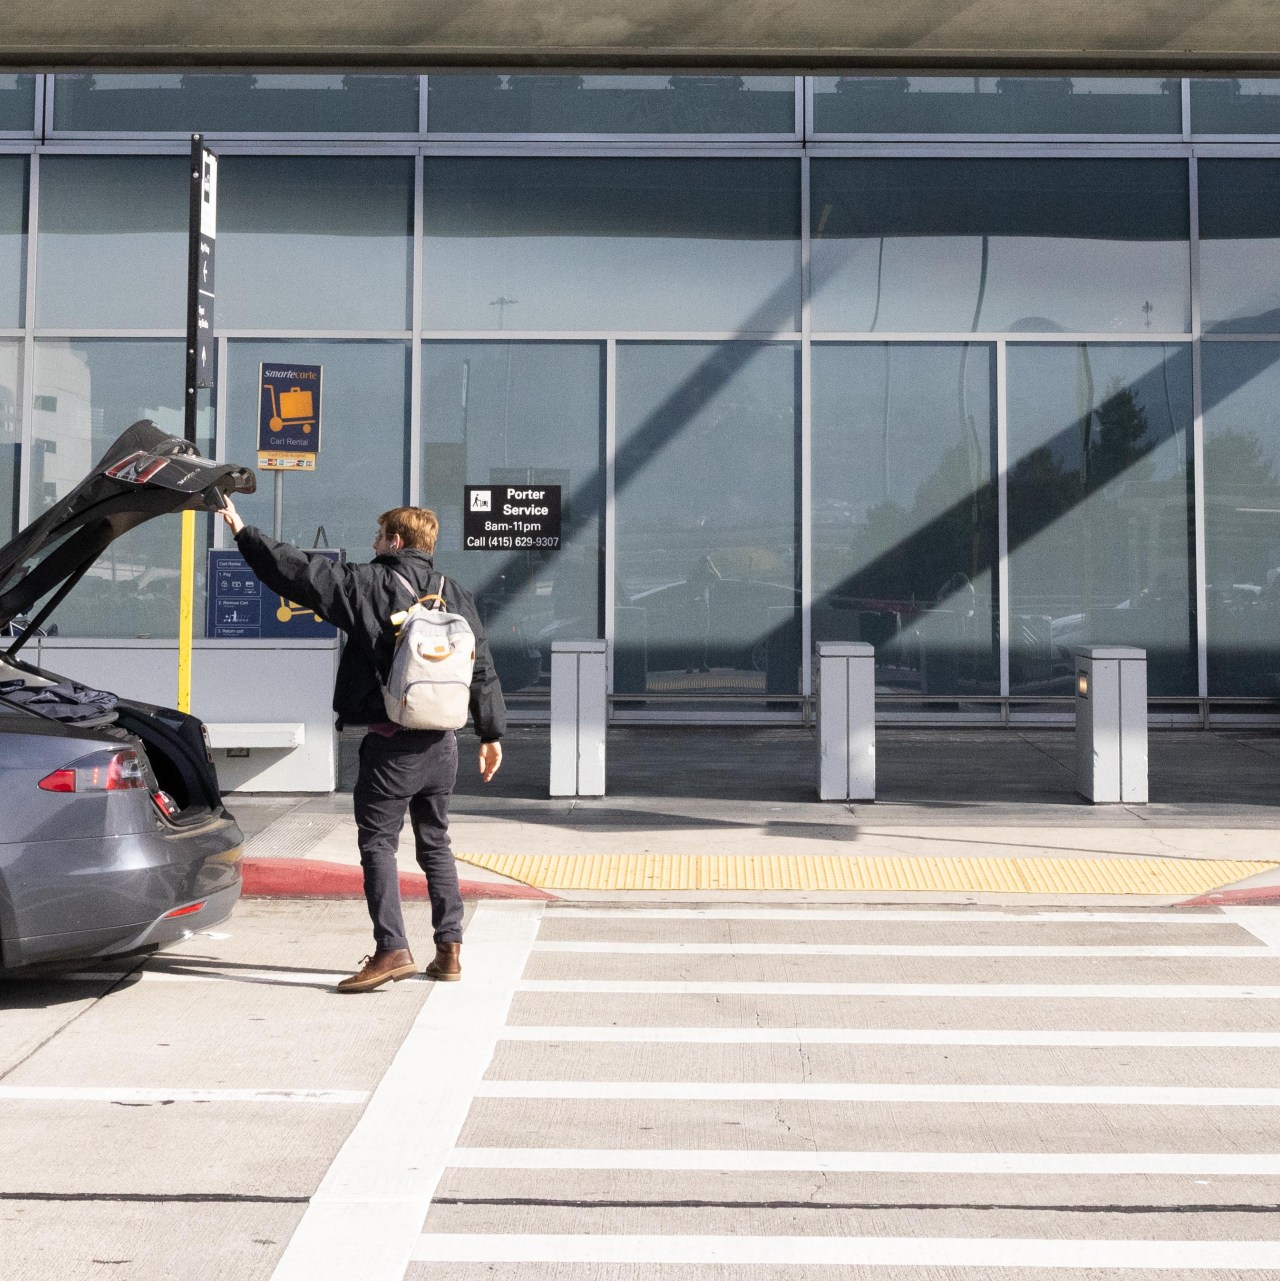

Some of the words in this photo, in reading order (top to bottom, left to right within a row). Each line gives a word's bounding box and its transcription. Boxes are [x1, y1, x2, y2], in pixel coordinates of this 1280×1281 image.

[270, 437, 284, 445] Cart
[286, 438, 309, 446] Rental
[507, 488, 545, 499] Porter
[503, 504, 549, 515] Service
[485, 521, 541, 533] 8am-11pm
[467, 537, 485, 546] Call
[488, 536, 512, 547] (415)
[515, 537, 559, 547] 629-9307
